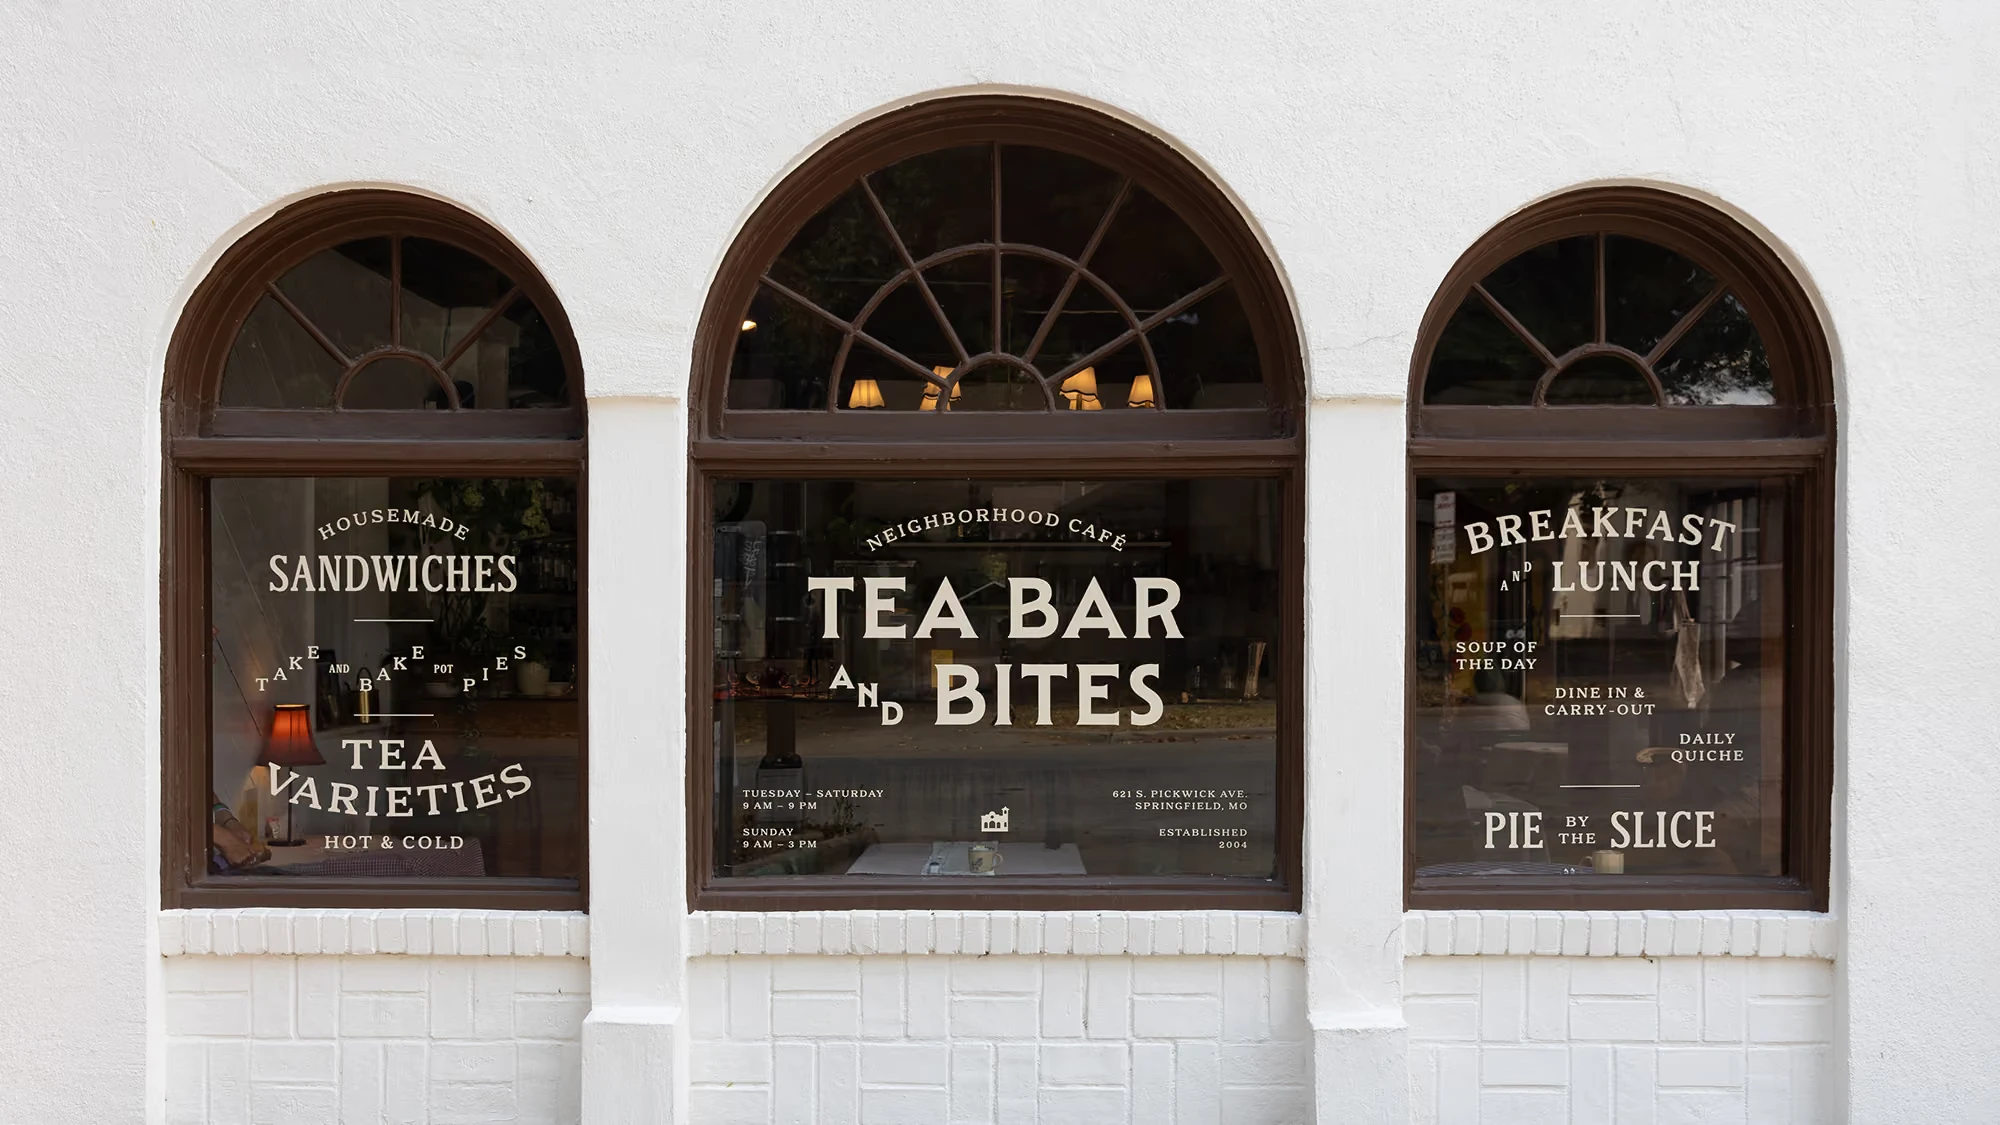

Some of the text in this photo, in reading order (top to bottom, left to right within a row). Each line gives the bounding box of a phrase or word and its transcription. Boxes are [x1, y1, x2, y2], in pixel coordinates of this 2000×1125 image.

[317, 508, 470, 541] HOUSEMADE
[866, 508, 1126, 552] NEIGHBORHOOD CAFÉ
[1463, 506, 1737, 555] BREAKFAST
[269, 554, 517, 593] SANDWICHES
[1500, 560, 1700, 592] AND LUNCH
[807, 576, 1185, 639] TEA BAR
[1456, 641, 1538, 653] SOUP OF
[255, 645, 526, 692] TAKE AND BAKE POT PIES
[1455, 658, 1537, 670] THE DAY
[828, 663, 1164, 726] AND BITES
[1555, 686, 1645, 699] DINE IN &
[1544, 703, 1656, 716] CARRY-OUT
[1679, 733, 1736, 745] DAILY
[341, 739, 446, 770] TEA
[1670, 749, 1744, 764] QUICHE
[268, 761, 532, 817] VARIETIES
[742, 789, 801, 798] TUESDAY
[816, 789, 884, 798] SATURDAY
[1112, 789, 1248, 798] 621 S. PICKWICK AVE.
[742, 802, 749, 810] 9
[753, 801, 772, 810] AM
[788, 801, 795, 810] 9
[799, 801, 817, 810] PM
[1135, 801, 1248, 811] SPRINGFIELD, MO
[742, 828, 794, 837] SUNDAY
[1159, 828, 1248, 837] ESTABLISHED
[1484, 810, 1716, 849] PIE BY THE SLICE
[324, 835, 464, 850] HOT & COLD
[742, 840, 750, 848] 9
[753, 840, 773, 849] AM
[788, 840, 795, 849] 3
[799, 840, 817, 848] PM
[1219, 840, 1247, 849] 2004
